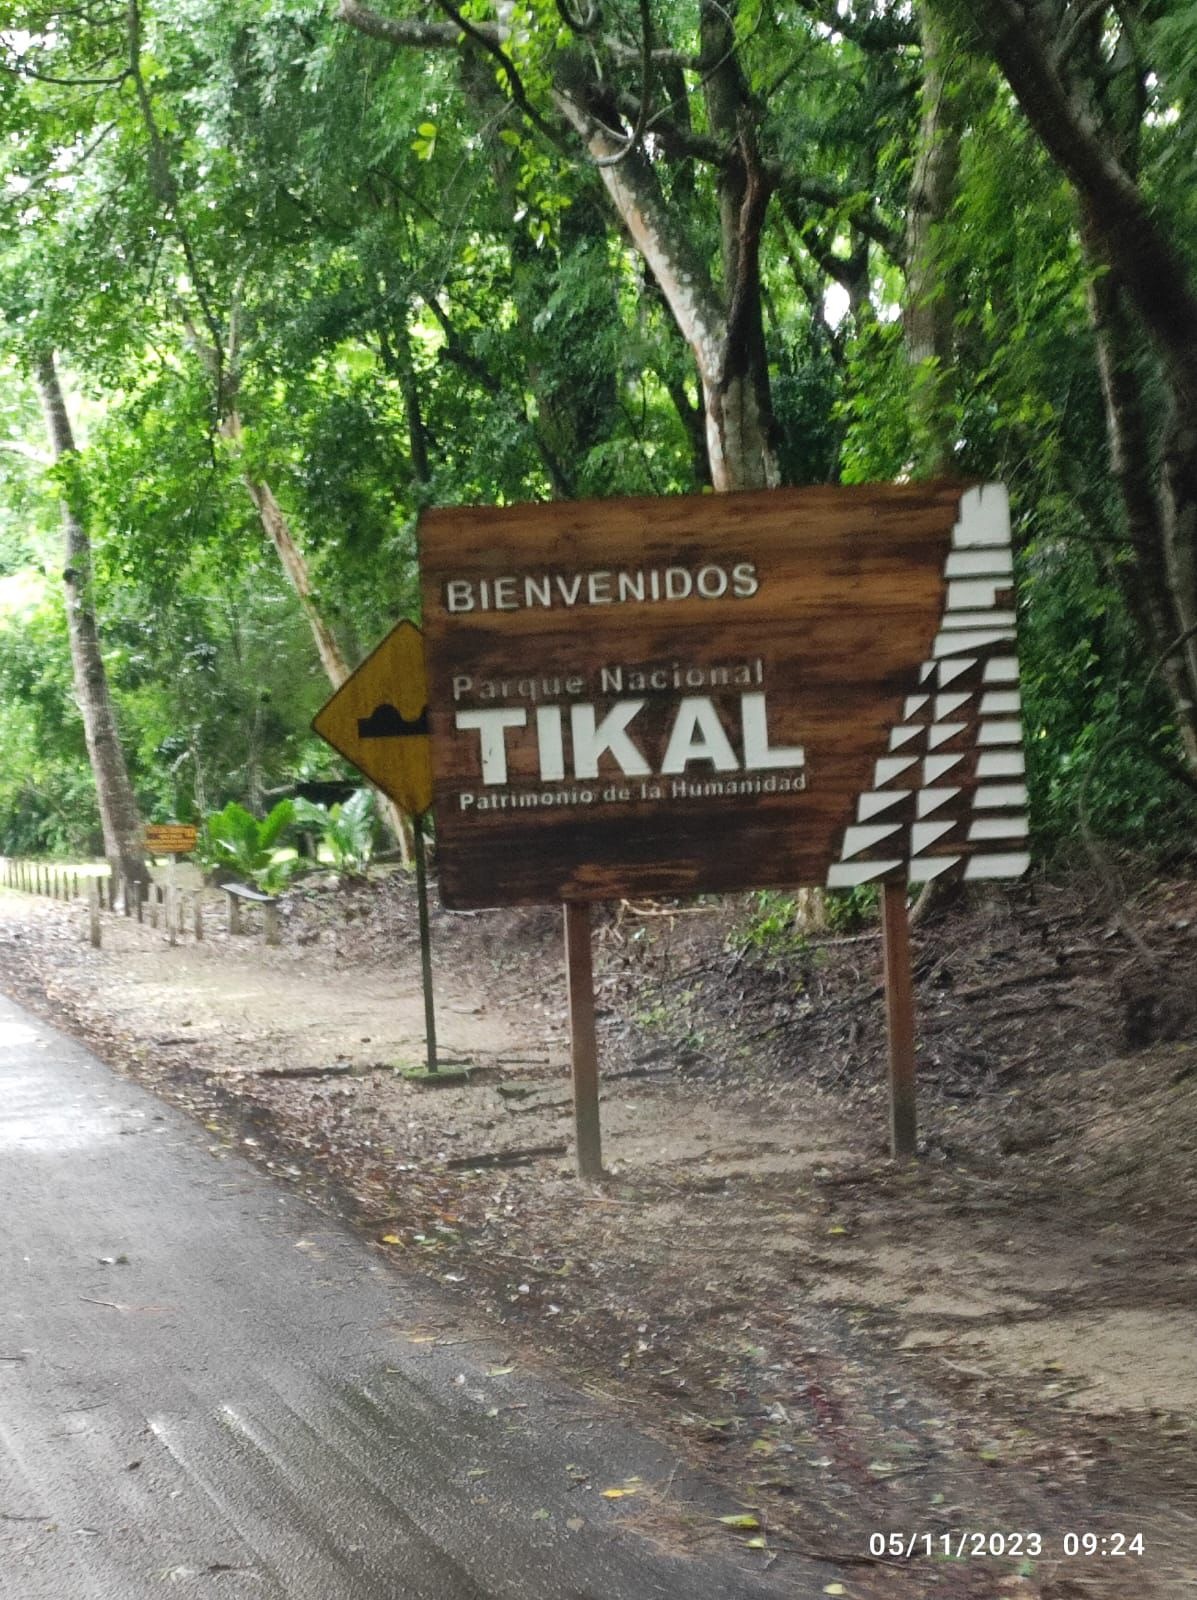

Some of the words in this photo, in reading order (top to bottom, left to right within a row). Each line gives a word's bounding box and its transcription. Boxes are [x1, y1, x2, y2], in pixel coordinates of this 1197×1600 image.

[447, 563, 759, 613] BIENVENIDOS
[453, 672, 585, 702] Parque
[600, 658, 764, 693] Nacional
[455, 691, 805, 785] TIKAL
[459, 788, 593, 811] Patrimonio
[603, 783, 635, 802] de
[641, 782, 662, 800] la
[672, 773, 807, 798] Humanidad
